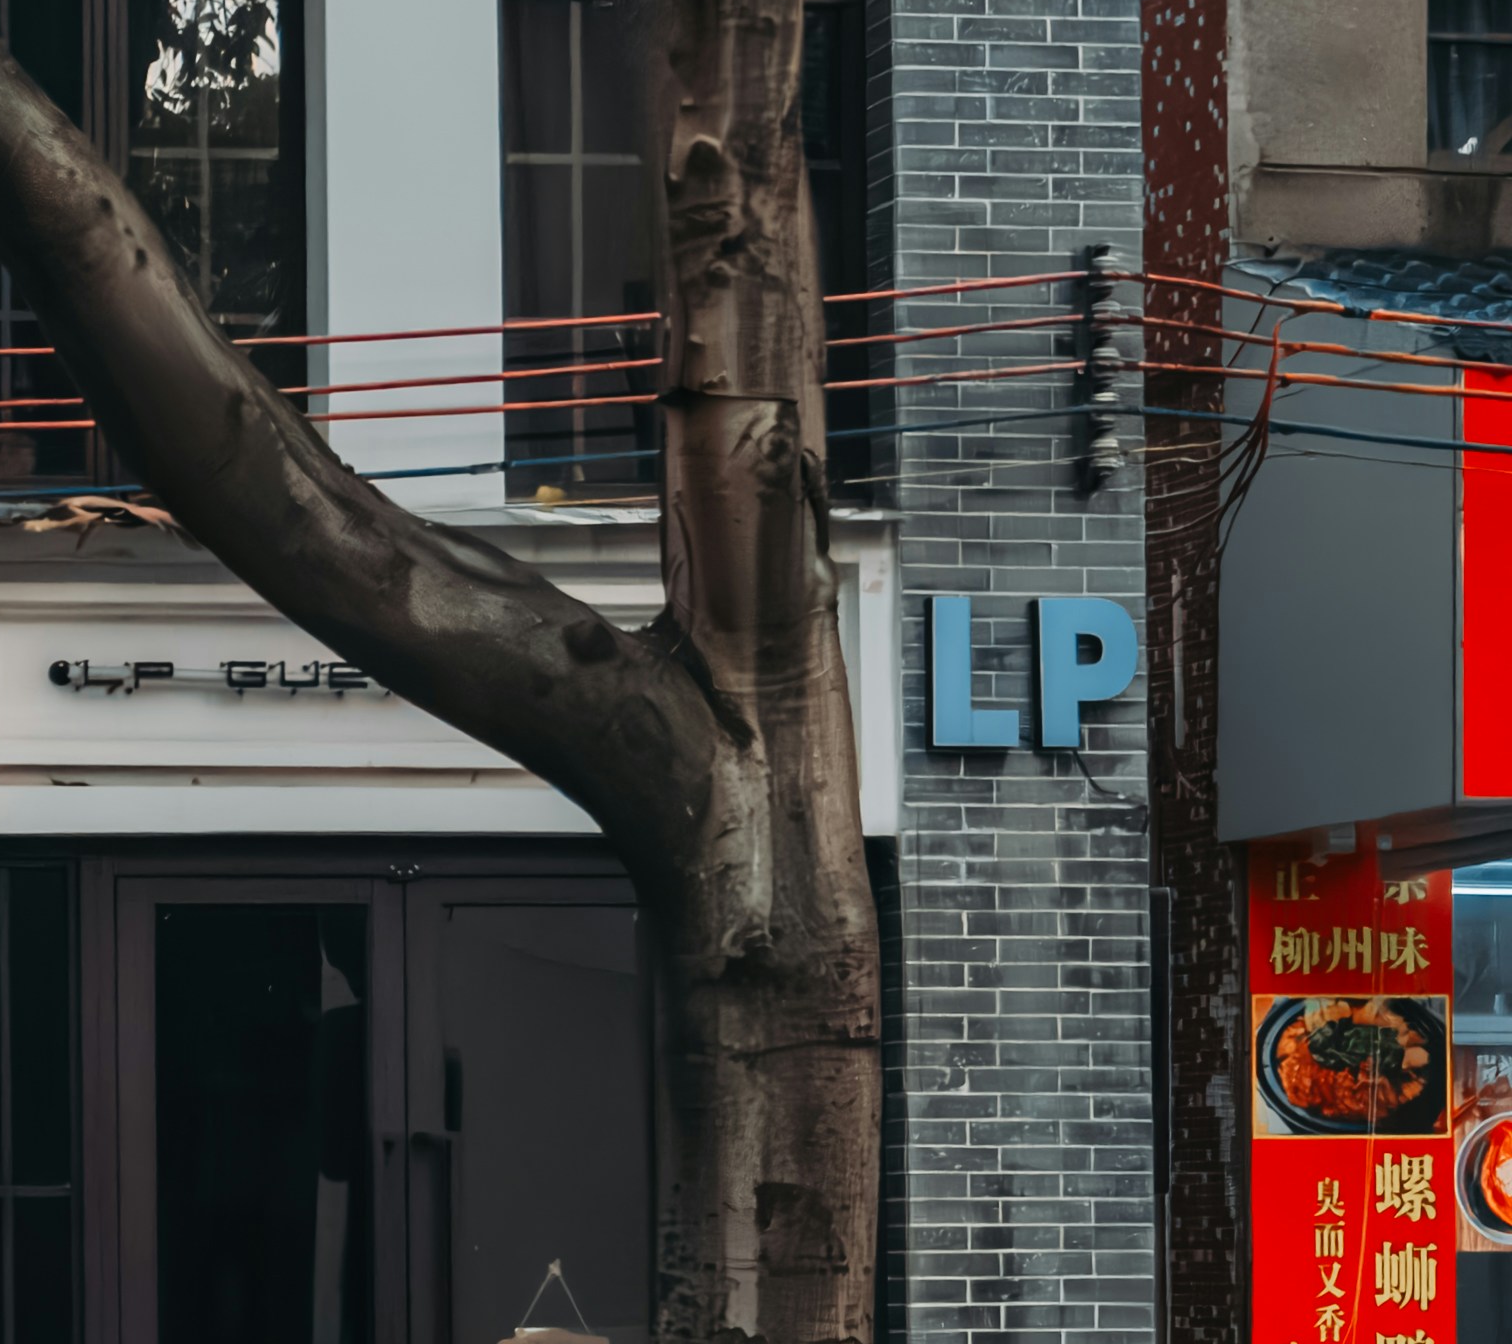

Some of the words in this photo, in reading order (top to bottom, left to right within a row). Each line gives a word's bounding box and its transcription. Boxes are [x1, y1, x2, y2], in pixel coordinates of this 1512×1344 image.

[926, 596, 1139, 748] LP
[1270, 926, 1431, 975] 柳州味
[1313, 1176, 1346, 1343] 臭而又香
